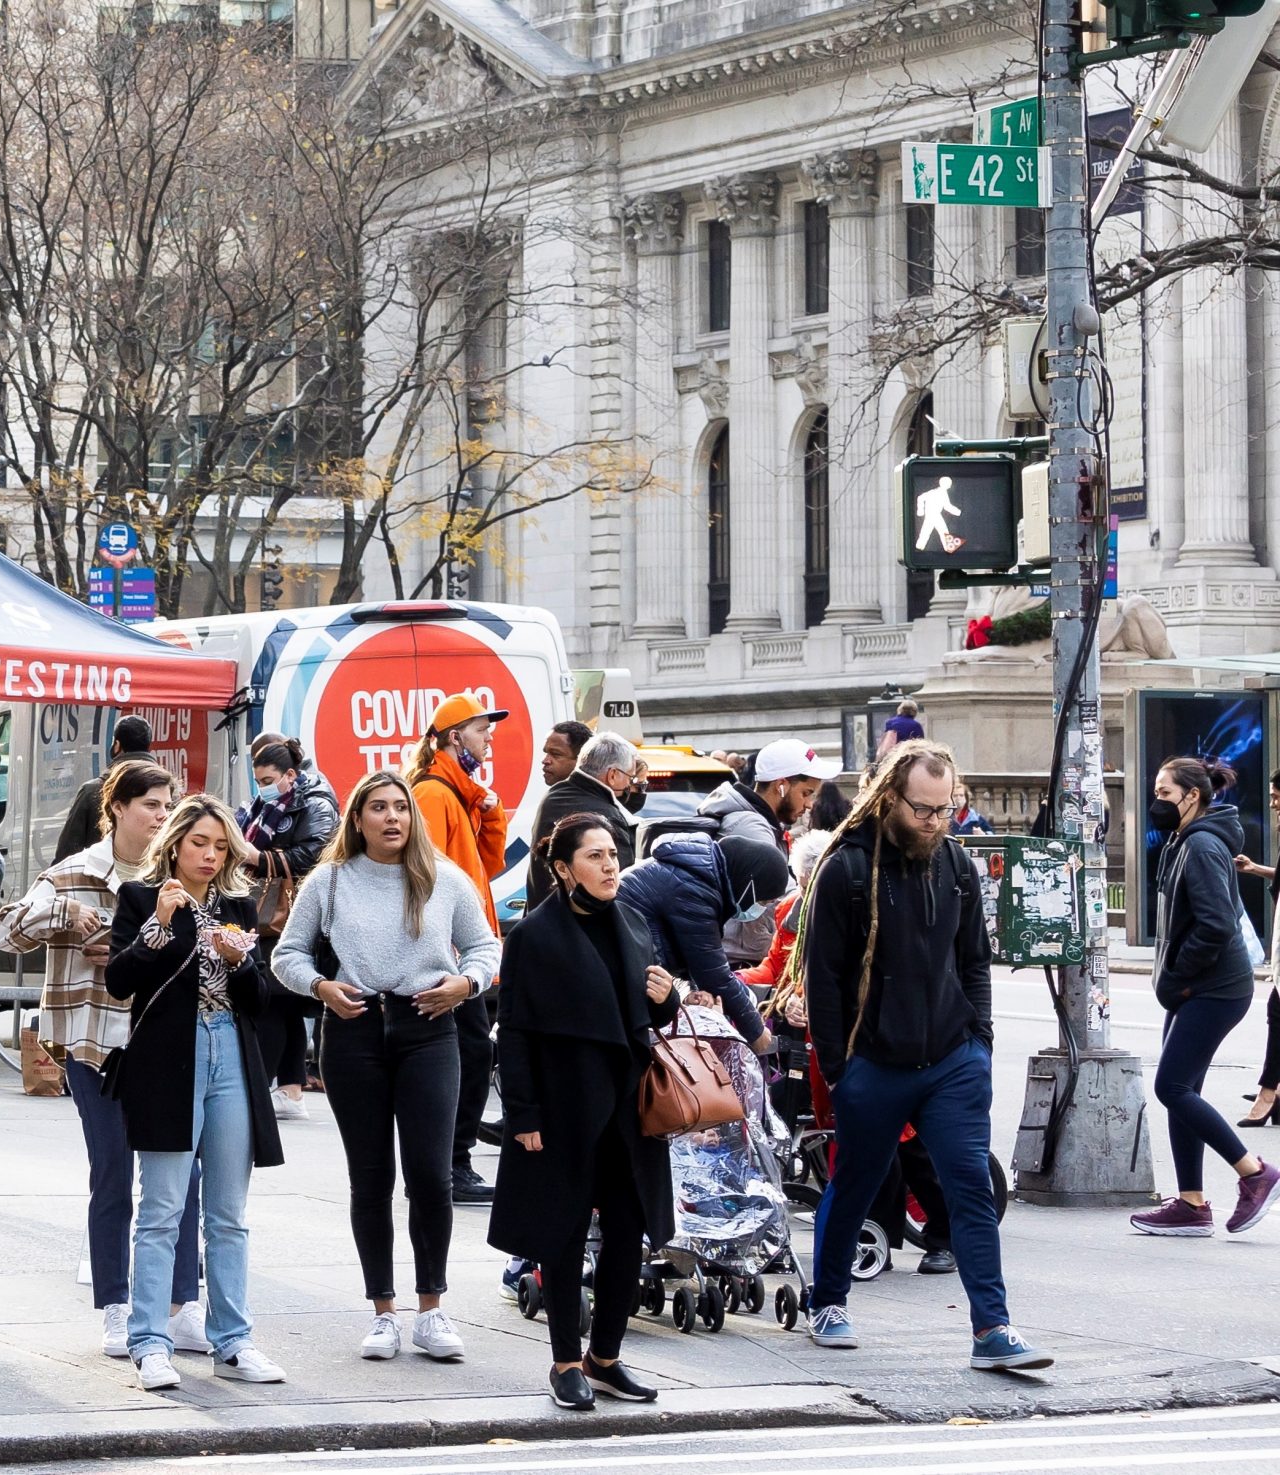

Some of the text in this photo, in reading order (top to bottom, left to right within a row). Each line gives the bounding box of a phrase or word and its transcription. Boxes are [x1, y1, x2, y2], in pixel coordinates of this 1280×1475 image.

[1002, 108, 1033, 147] 5 Av
[940, 153, 1035, 198] E 42 St
[39, 704, 80, 745] CTS
[609, 703, 630, 717] 7L44
